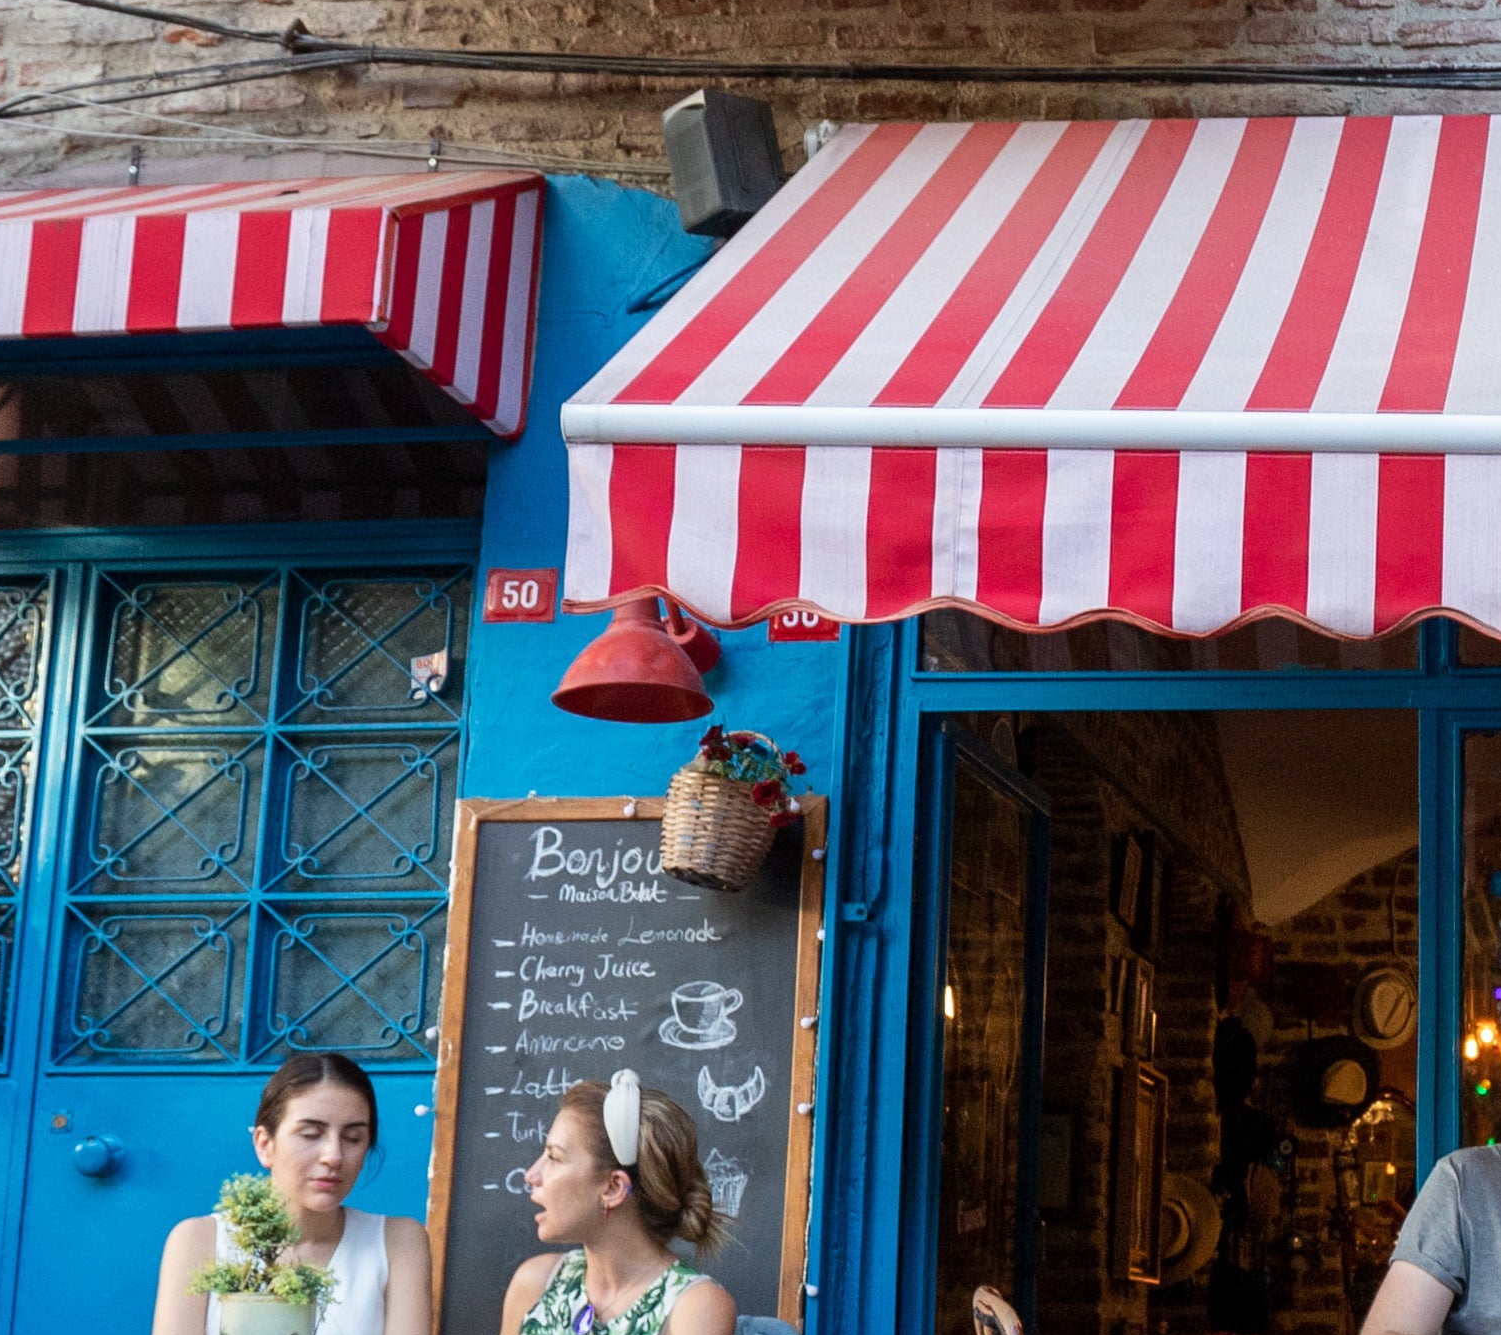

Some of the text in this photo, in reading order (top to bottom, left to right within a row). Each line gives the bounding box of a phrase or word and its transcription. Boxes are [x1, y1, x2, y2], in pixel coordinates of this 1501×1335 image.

[501, 580, 540, 610] 50
[523, 825, 667, 889] Bonjou
[618, 916, 722, 947] Lemonade
[519, 953, 657, 987] Cherry Juice
[518, 987, 639, 1022] Breakfast
[509, 1068, 583, 1099] Latt
